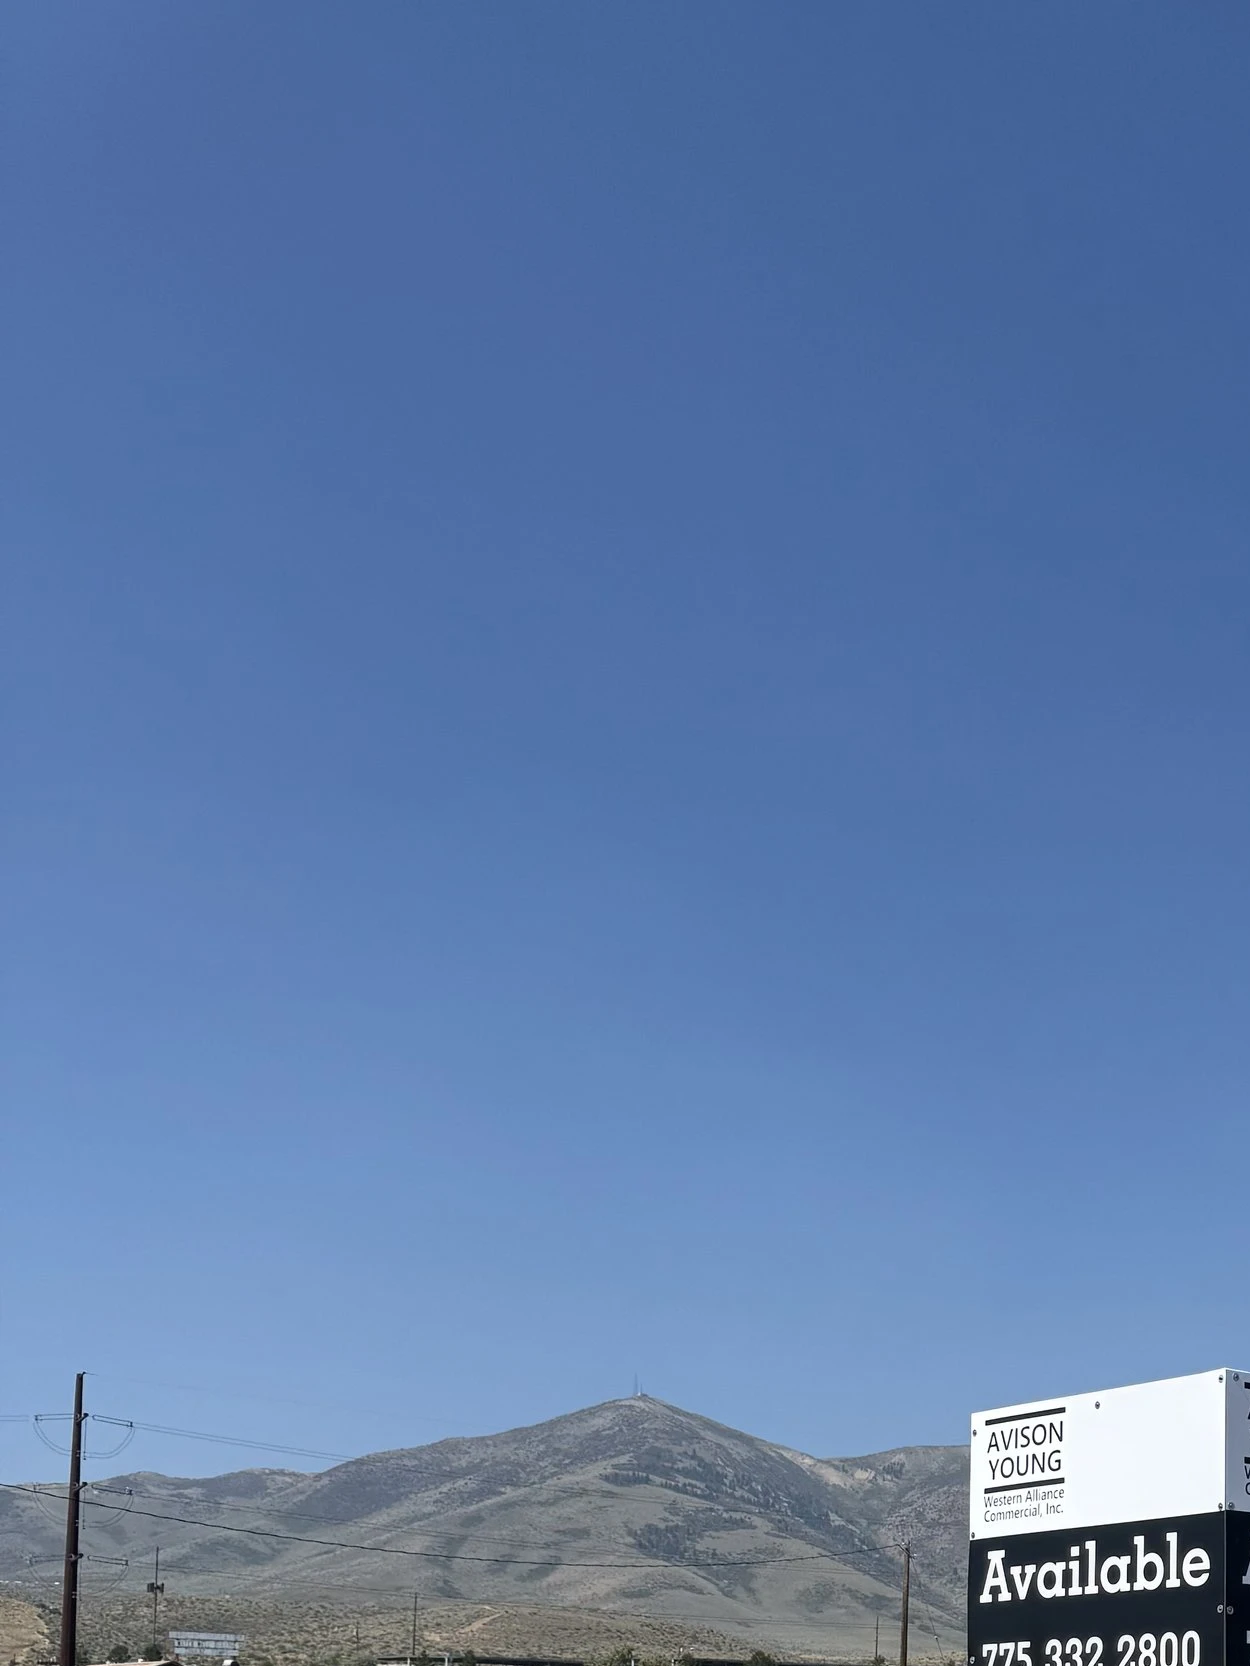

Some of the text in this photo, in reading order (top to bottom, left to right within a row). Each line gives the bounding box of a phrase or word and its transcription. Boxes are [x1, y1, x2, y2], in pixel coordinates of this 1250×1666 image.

[987, 1420, 1064, 1453] AVISON
[988, 1450, 1062, 1480] YOUNG
[984, 1487, 1065, 1508] Western Alliance
[984, 1503, 1064, 1523] Commercial, Inc.
[979, 1531, 1211, 1604] Available
